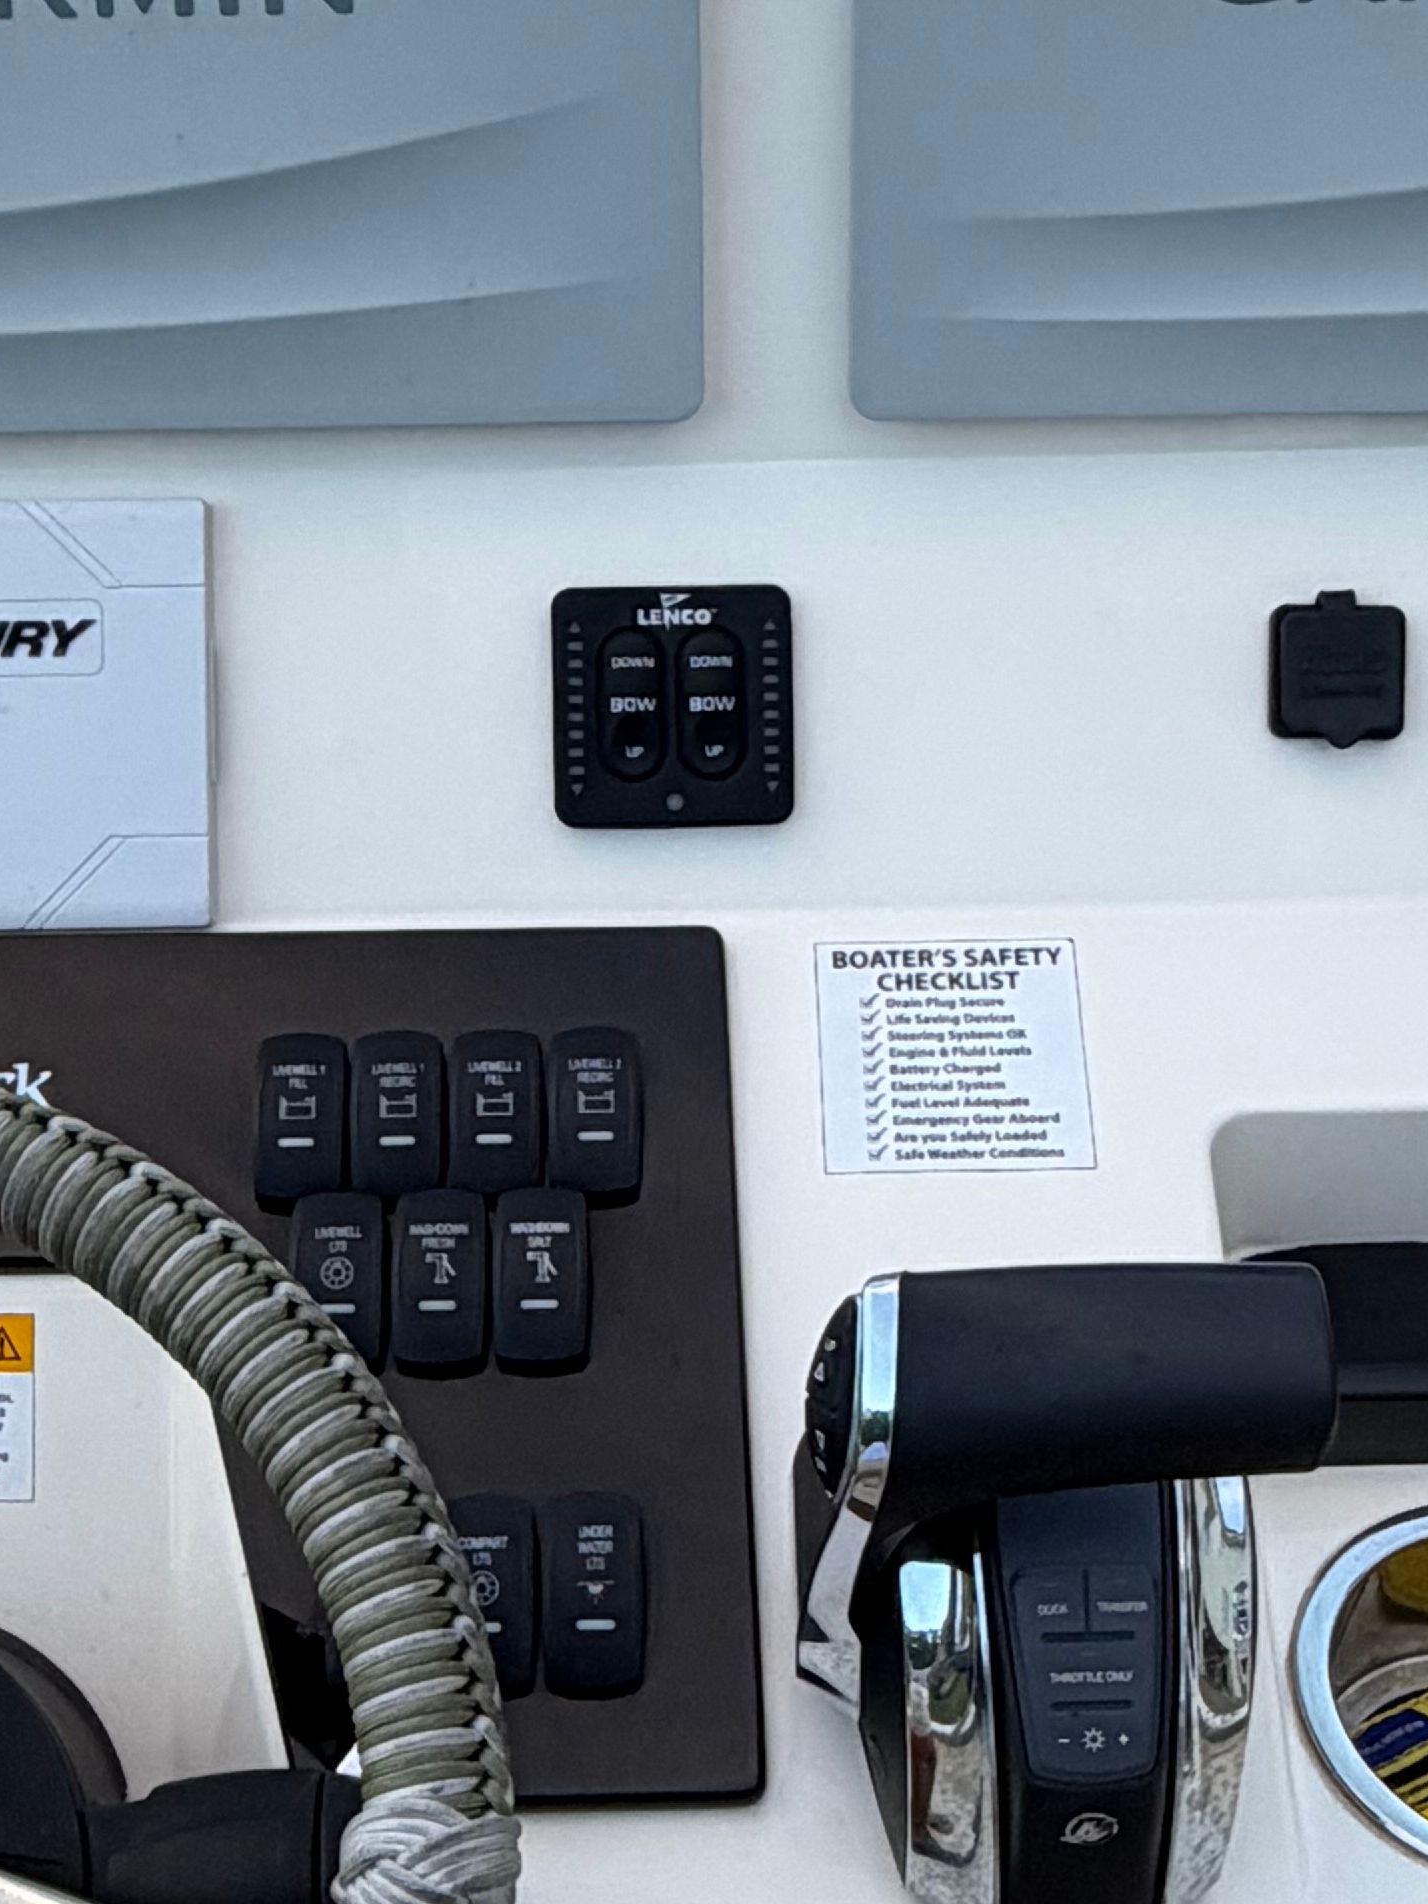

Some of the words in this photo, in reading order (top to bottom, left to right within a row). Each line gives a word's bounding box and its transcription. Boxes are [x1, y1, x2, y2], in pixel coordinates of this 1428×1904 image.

[636, 608, 713, 631] LENCO
[610, 656, 656, 670] DOWN
[689, 655, 734, 669] DOWN
[609, 696, 657, 714] BOW
[688, 695, 736, 713] BOW
[625, 745, 645, 759] UP
[704, 744, 724, 758] UP
[964, 947, 1062, 967] SAFETY
[877, 971, 1020, 991] CHECKLIST
[885, 998, 923, 1008] Drain
[925, 997, 956, 1009] Plug
[959, 997, 1004, 1007] Secure
[886, 1014, 912, 1025] Life
[915, 1014, 961, 1026] Saving
[964, 1013, 1015, 1024] Devices
[887, 1031, 945, 1042] Steering
[948, 1030, 1004, 1042] Systems
[1006, 1029, 1027, 1039] OK
[889, 1047, 936, 1059] Engine
[952, 1046, 987, 1057] Fluid
[989, 1046, 1032, 1056] Levels
[889, 1064, 940, 1075] Battery
[943, 1063, 1002, 1074] Charged
[891, 1080, 954, 1092] Electrical
[957, 1080, 1006, 1092] System
[891, 1097, 921, 1108] Fuel
[923, 1097, 960, 1107] Level
[963, 1097, 1030, 1109] Adequate
[893, 1114, 970, 1126] Emergency
[973, 1114, 1005, 1124] Gear
[1009, 1113, 1060, 1124] Aboard
[894, 1132, 918, 1143] Are
[921, 1133, 947, 1144] you
[950, 1131, 992, 1143] Safely
[995, 1130, 1047, 1141] Loaded
[895, 1149, 926, 1160] Safe
[927, 1148, 986, 1159] Weather
[989, 1147, 1065, 1158] Conditions
